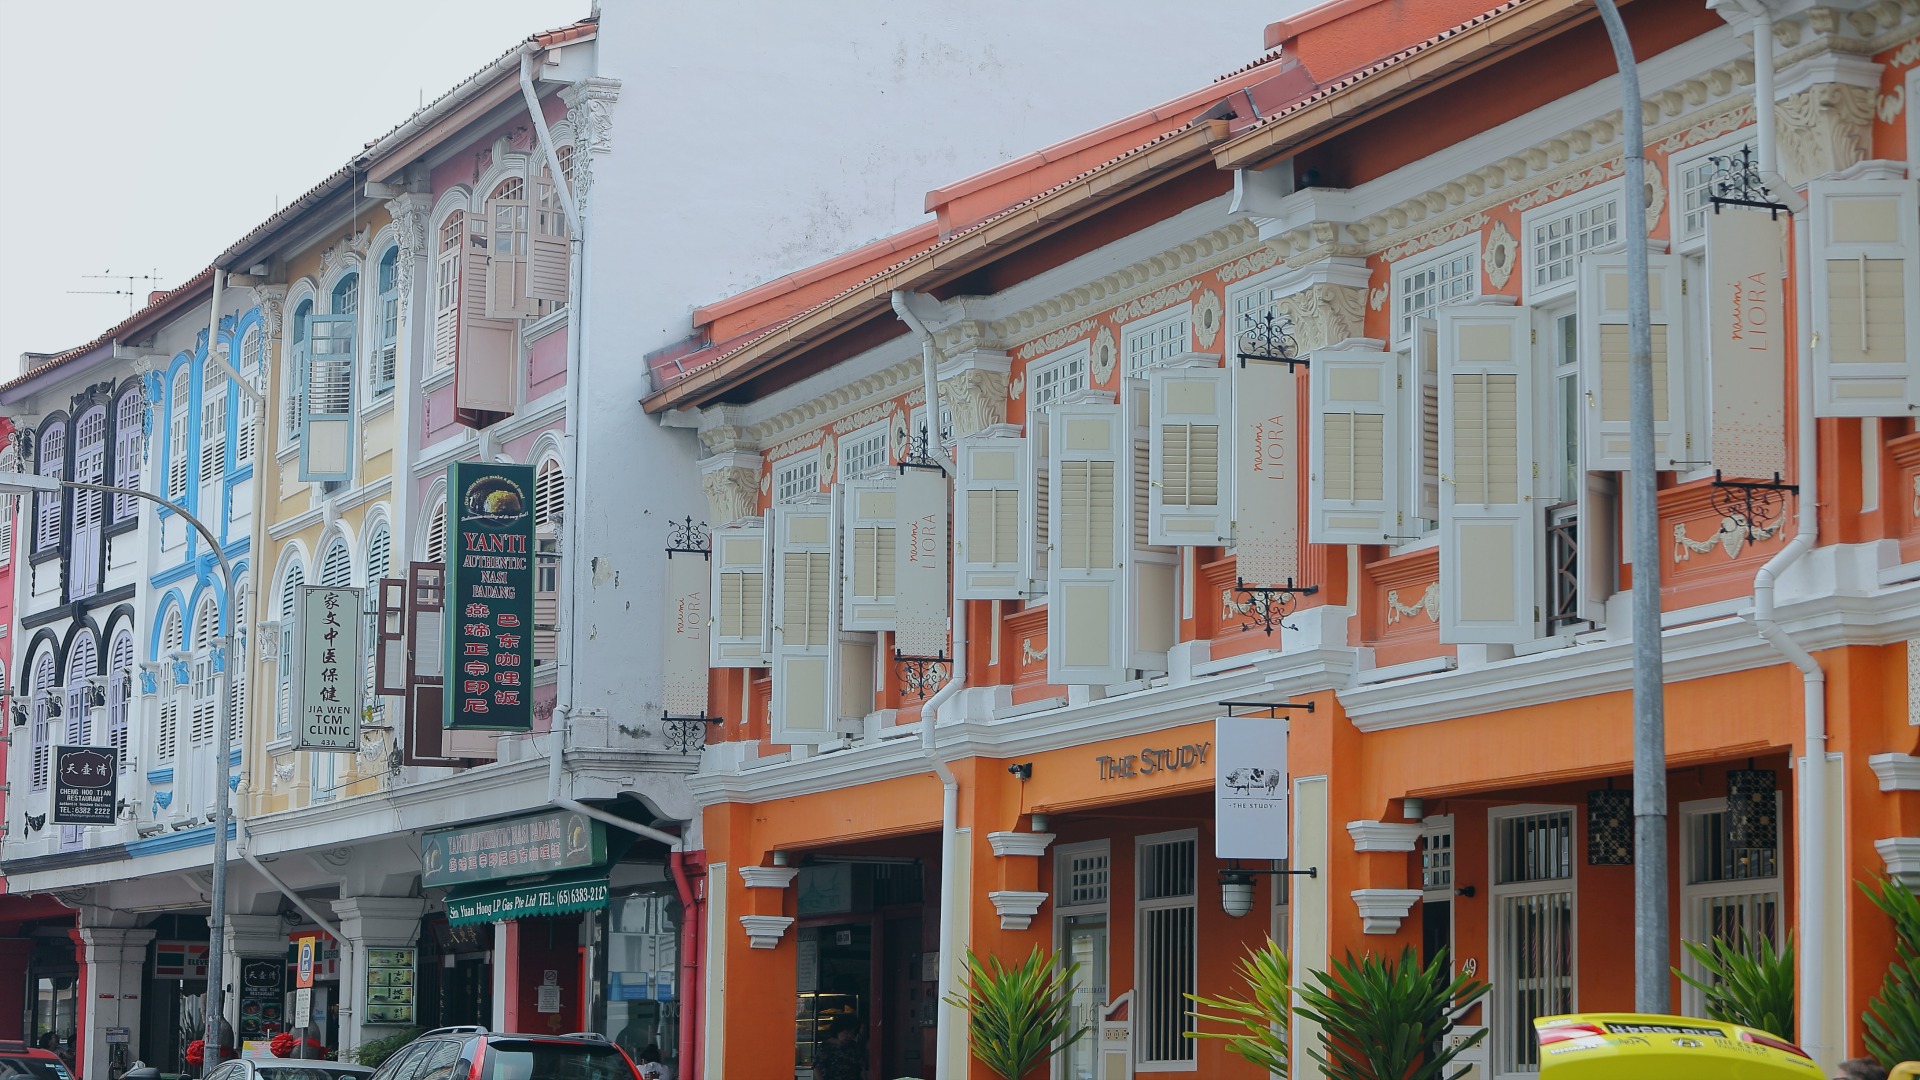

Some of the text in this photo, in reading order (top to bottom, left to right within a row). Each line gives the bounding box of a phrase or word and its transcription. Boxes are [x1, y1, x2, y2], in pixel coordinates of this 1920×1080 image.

[1747, 272, 1767, 350] LIORA
[1267, 415, 1284, 480] LIORA
[463, 532, 527, 554] YANTI
[922, 514, 936, 569] LIORA
[463, 554, 527, 570] AUTHENTIC
[480, 570, 508, 584] NASI
[472, 584, 516, 599] PADANG
[687, 591, 701, 640] LIORA
[319, 592, 341, 703] 家文中医保健
[308, 705, 351, 715] JIA WEN
[315, 714, 343, 725] TCM
[309, 725, 350, 736] CLINIC
[1096, 741, 1211, 781] THE STUDY
[530, 818, 560, 842] PADANG
[460, 904, 475, 918] Yuan
[476, 901, 492, 917] Hong
[493, 899, 501, 913] LP
[502, 898, 513, 912] Gas
[524, 893, 537, 908] Ltd
[538, 891, 555, 907] TEL:
[188, 958, 209, 966] ELEVE
